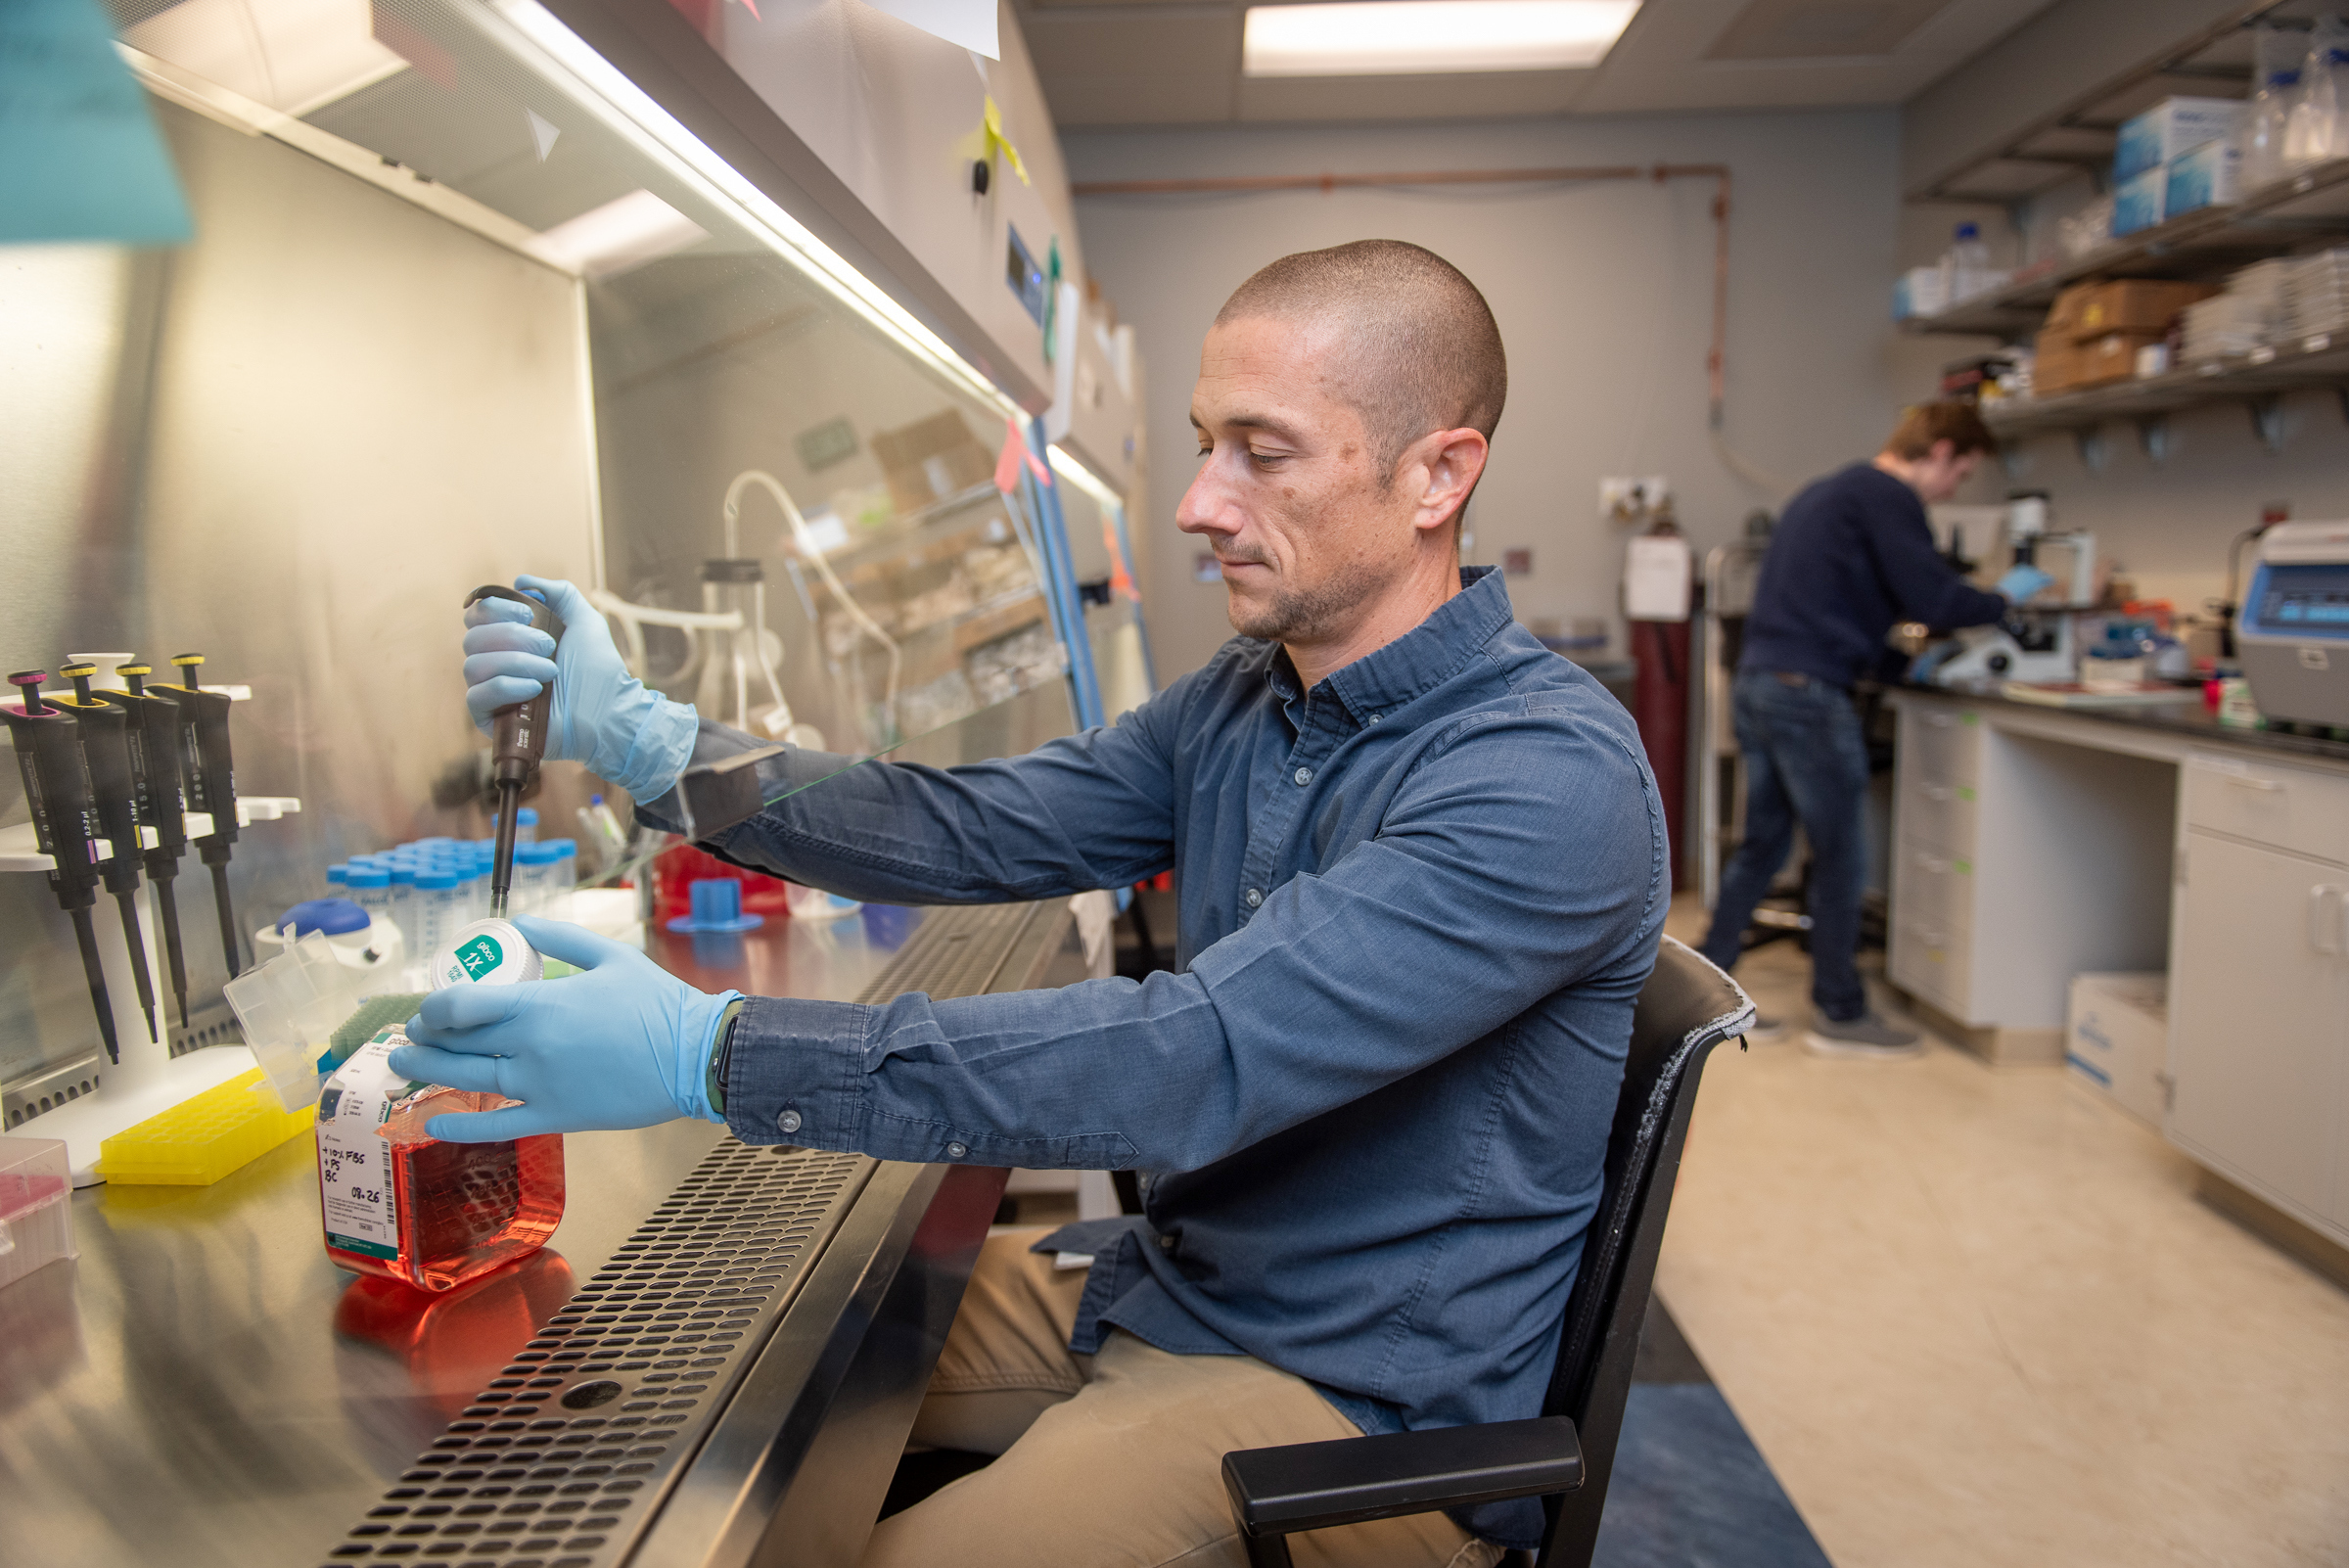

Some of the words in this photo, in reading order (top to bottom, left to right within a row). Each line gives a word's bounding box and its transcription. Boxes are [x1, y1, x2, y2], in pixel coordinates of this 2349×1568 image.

[82, 818, 92, 837] 0.2-2
[476, 941, 496, 962] gibco
[463, 951, 484, 972] 1X
[450, 964, 464, 980] RPMI
[377, 1100, 388, 1123] gibco
[330, 1159, 341, 1171] PS
[345, 1150, 365, 1165] FBS
[325, 1170, 338, 1182] BC
